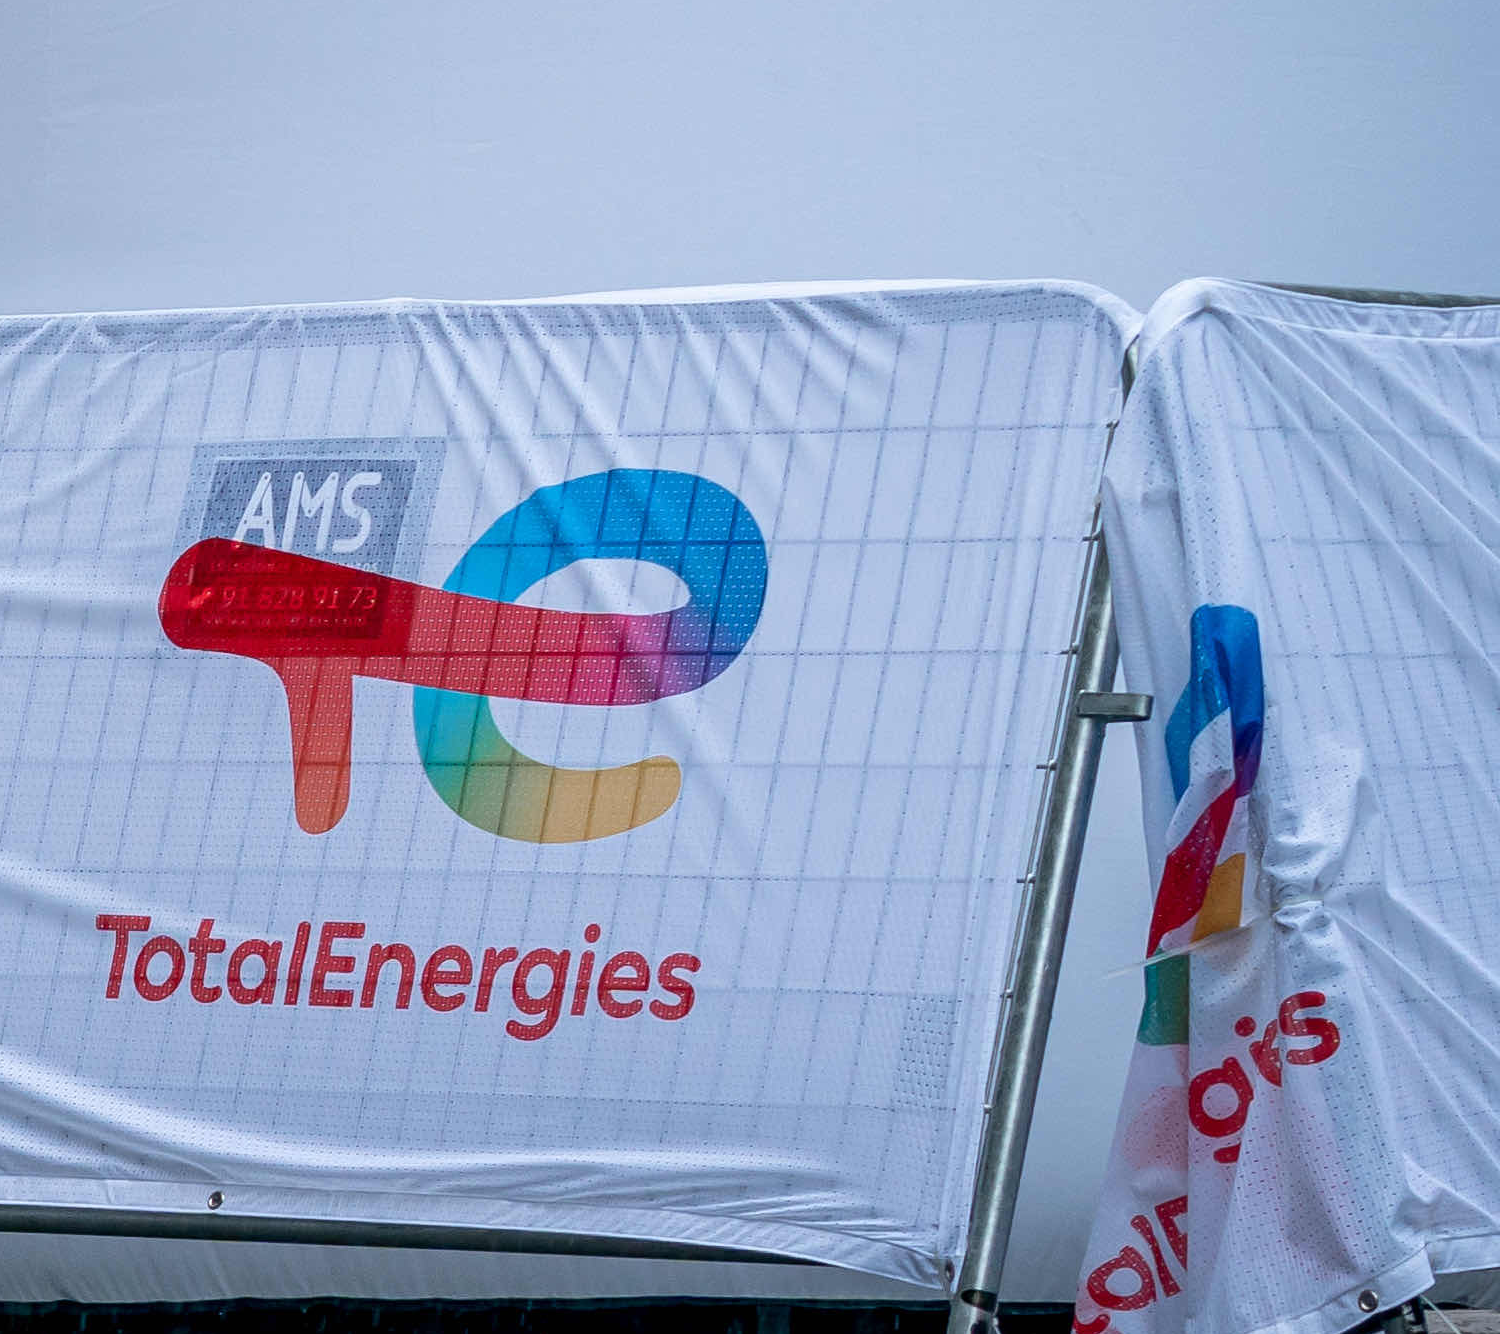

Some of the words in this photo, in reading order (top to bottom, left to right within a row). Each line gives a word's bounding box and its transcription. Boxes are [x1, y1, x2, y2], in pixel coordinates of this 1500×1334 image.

[231, 471, 383, 554] AMS
[348, 586, 380, 610] 73
[95, 913, 702, 1042] TotalEnergies
